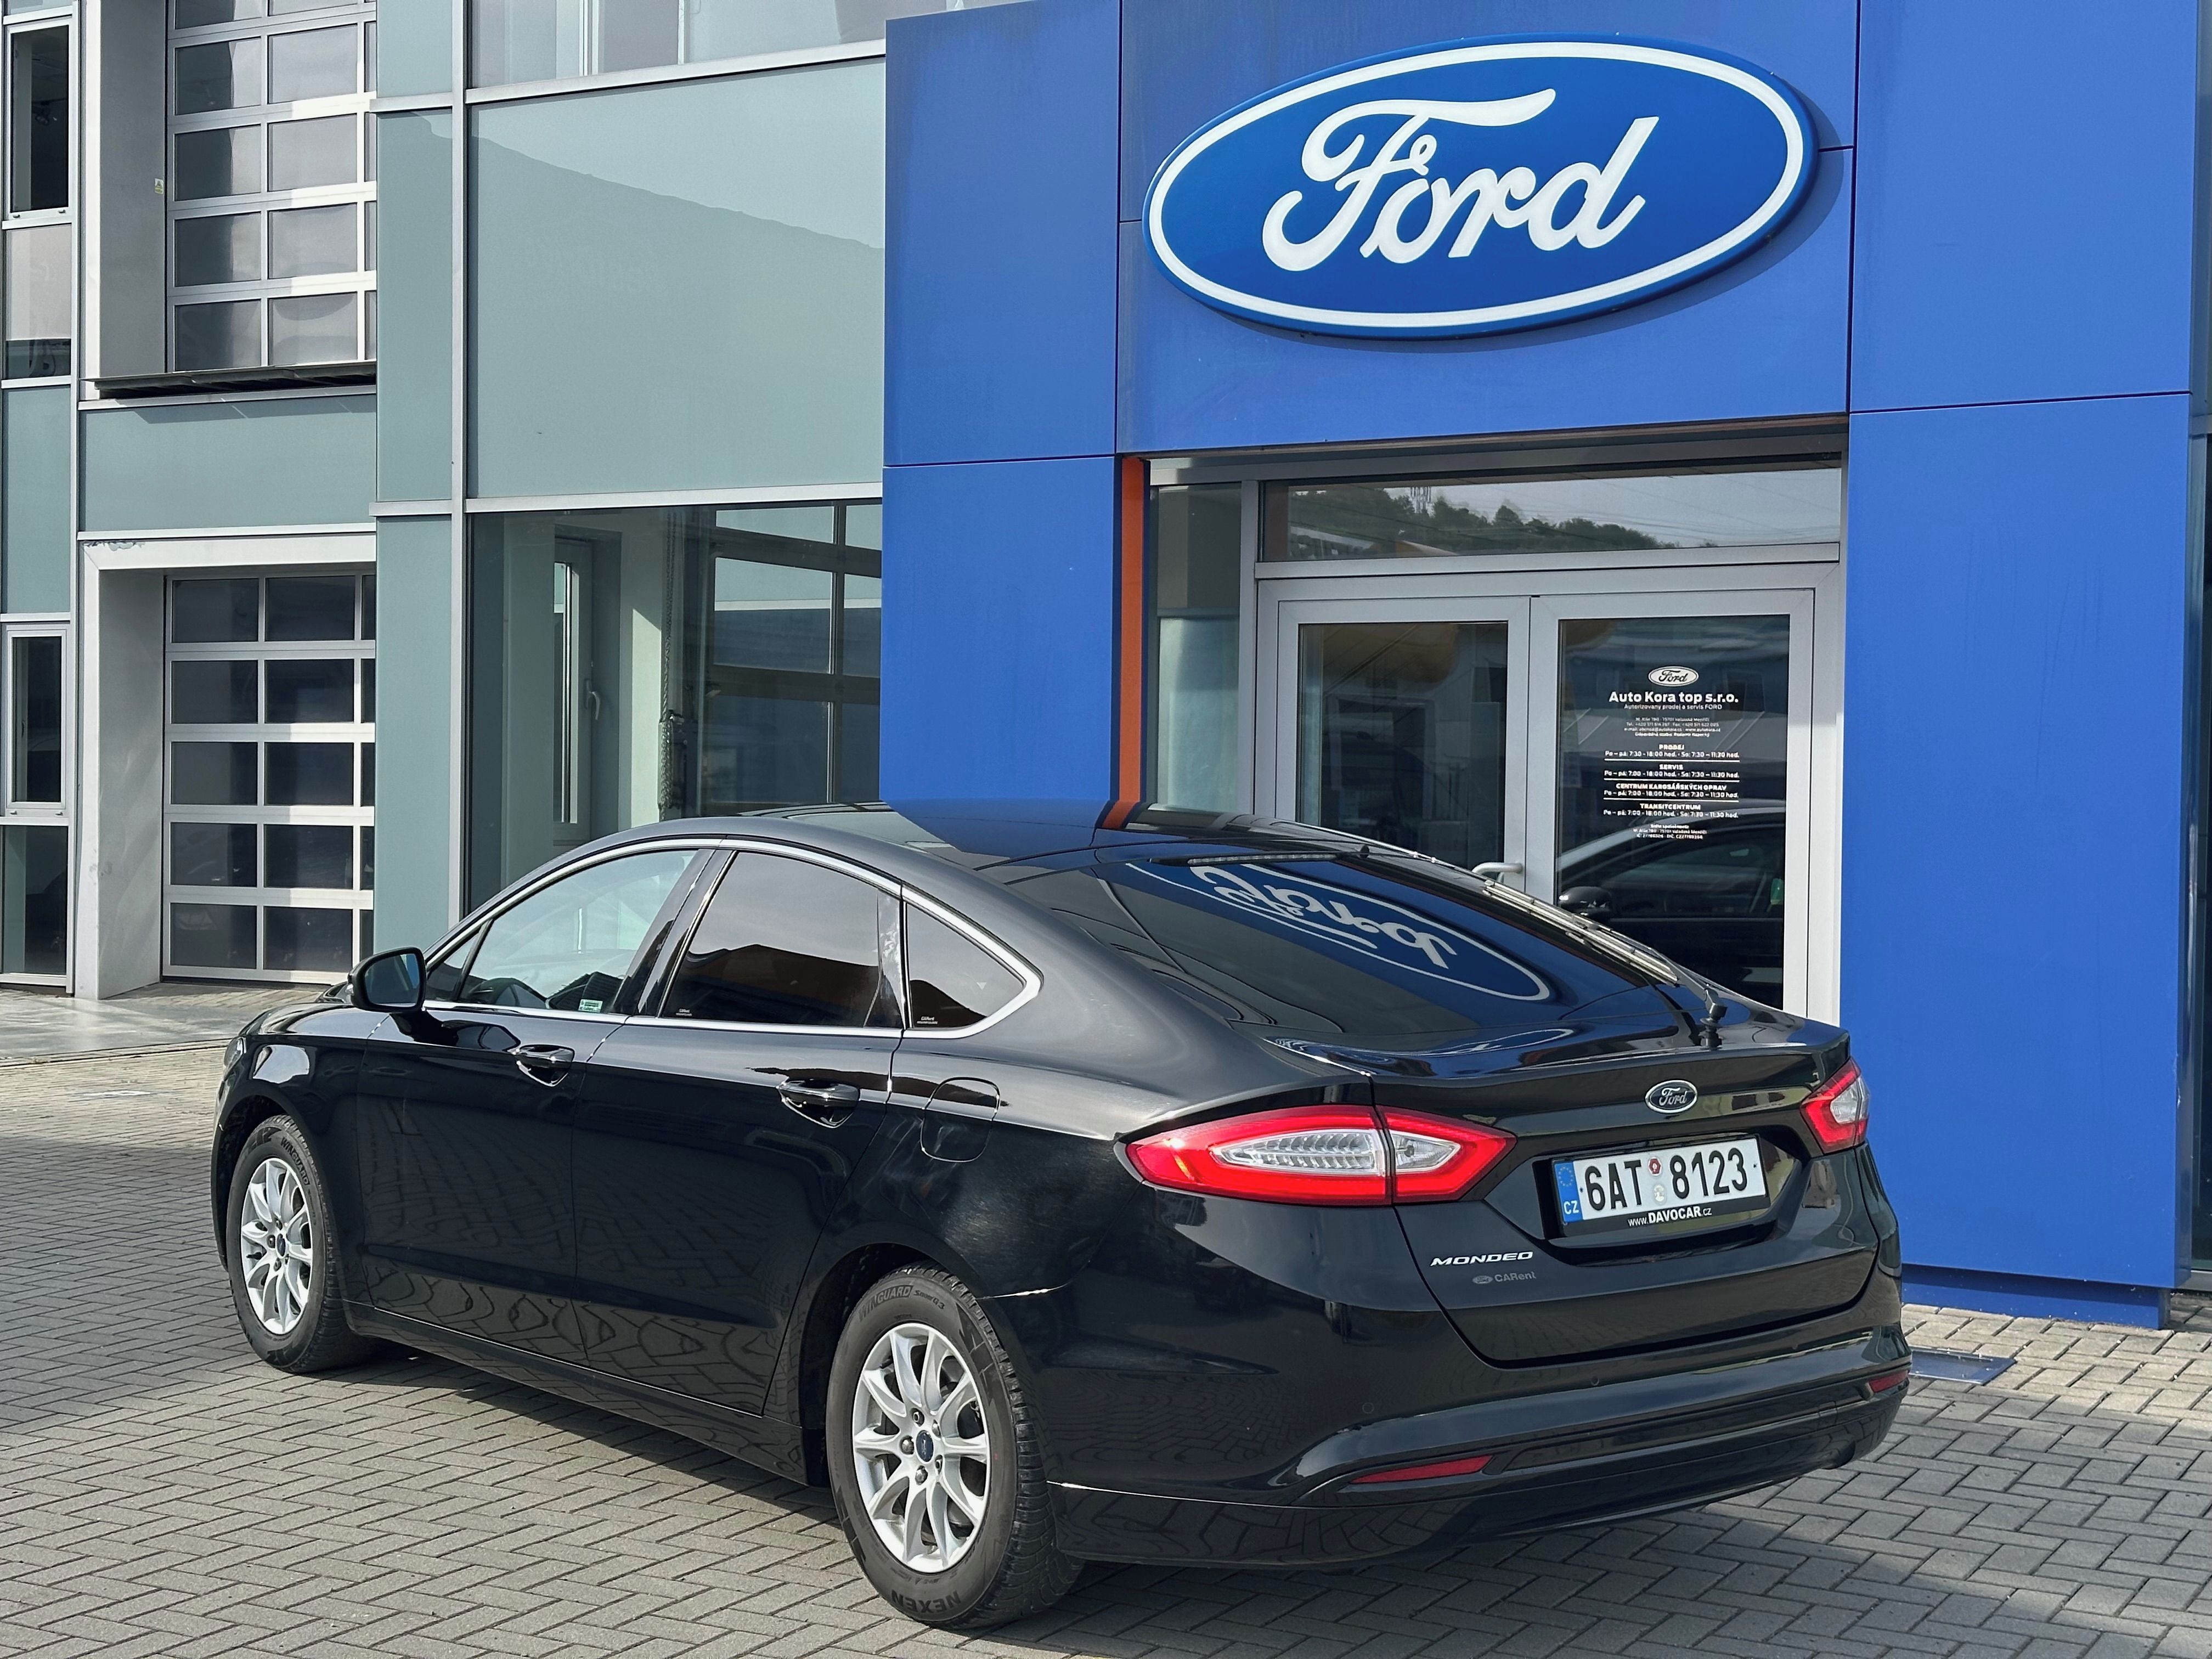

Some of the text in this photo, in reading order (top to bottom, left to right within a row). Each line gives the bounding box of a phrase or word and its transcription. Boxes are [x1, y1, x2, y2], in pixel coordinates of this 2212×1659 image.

[1262, 88, 1659, 272] Ford
[1658, 670, 1688, 682] Ford
[1609, 691, 1739, 704] Auto Kora top s.r.o.
[1659, 1087, 1688, 1106] Ford
[1584, 1148, 1747, 1211] 6AT 8123
[1564, 1200, 1579, 1215] CZ
[1430, 1251, 1533, 1267] MONDEO
[1494, 1271, 1536, 1282] CARent
[891, 1589, 961, 1613] NEXEN
